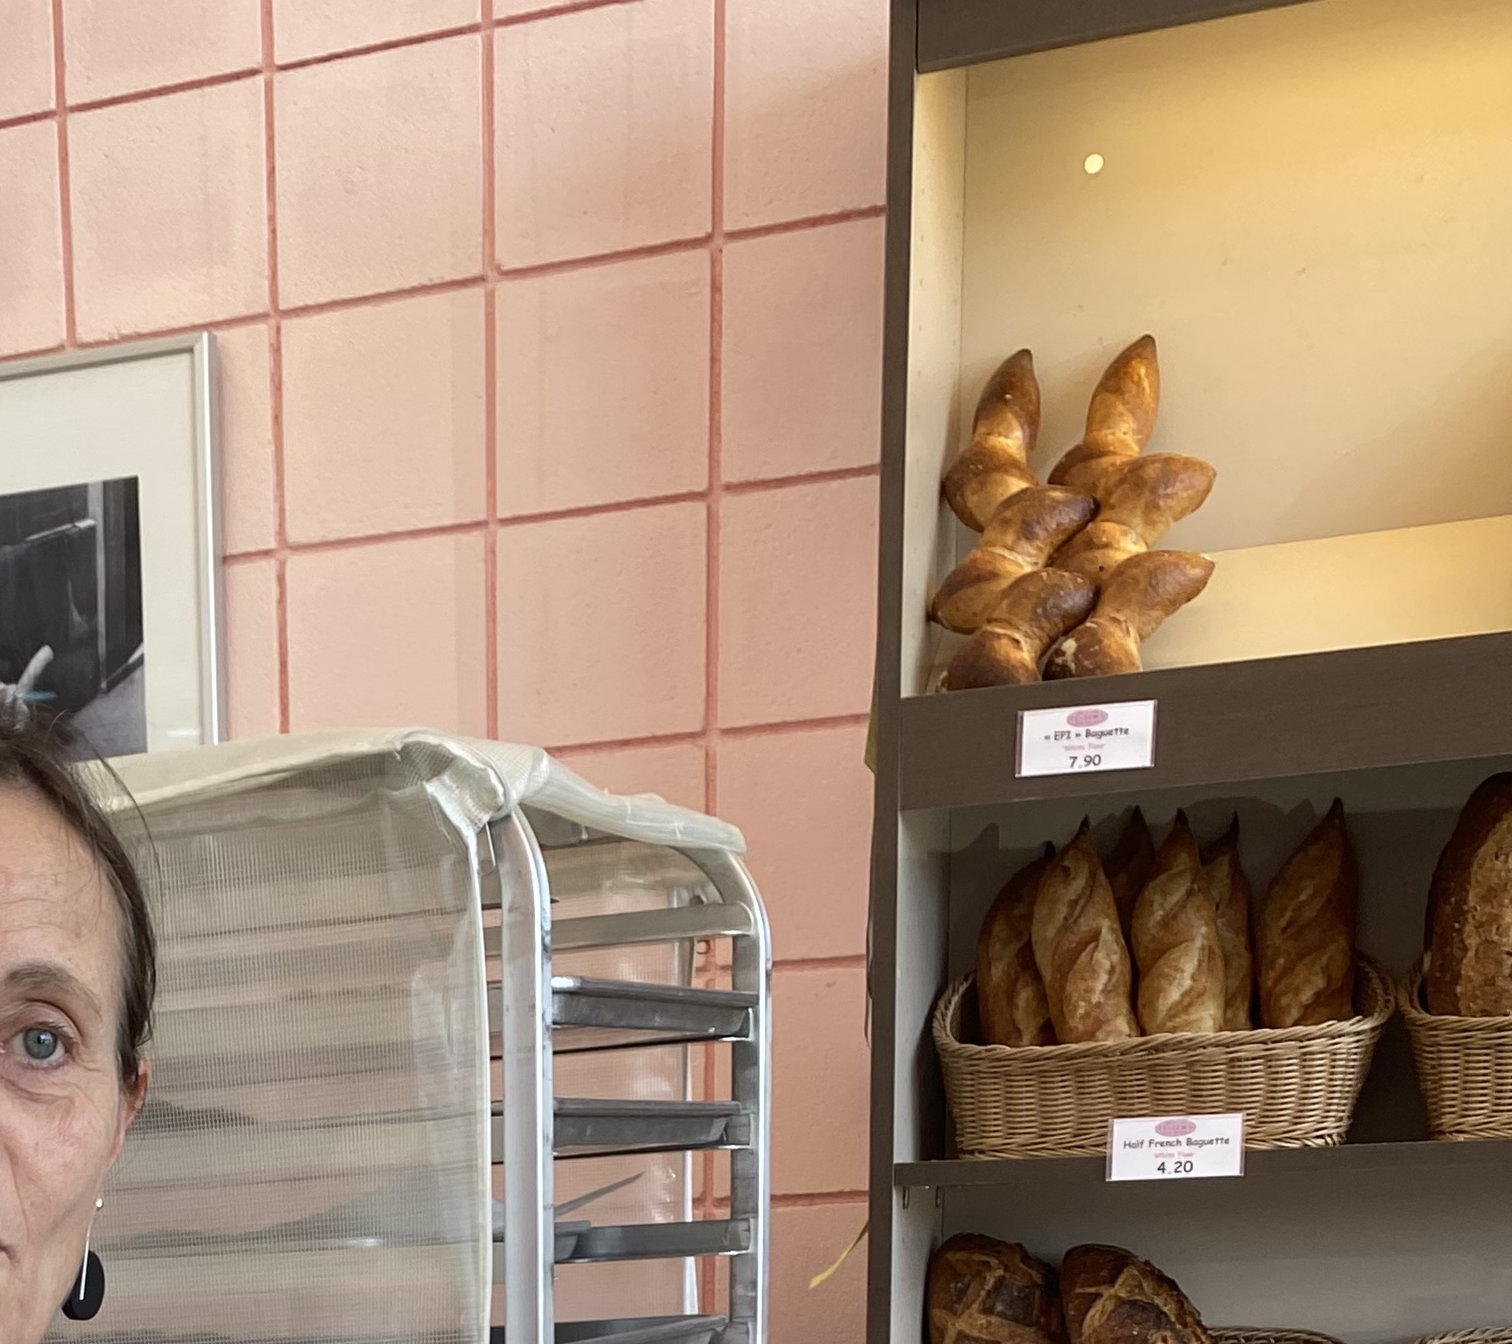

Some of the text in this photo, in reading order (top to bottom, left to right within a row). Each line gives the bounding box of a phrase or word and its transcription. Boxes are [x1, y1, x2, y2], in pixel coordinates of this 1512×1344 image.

[1085, 728, 1130, 740] Baguette
[1069, 754, 1102, 768] 7.90
[1123, 1137, 1230, 1149] Half French Baguette
[1157, 1160, 1194, 1174] 4.20
